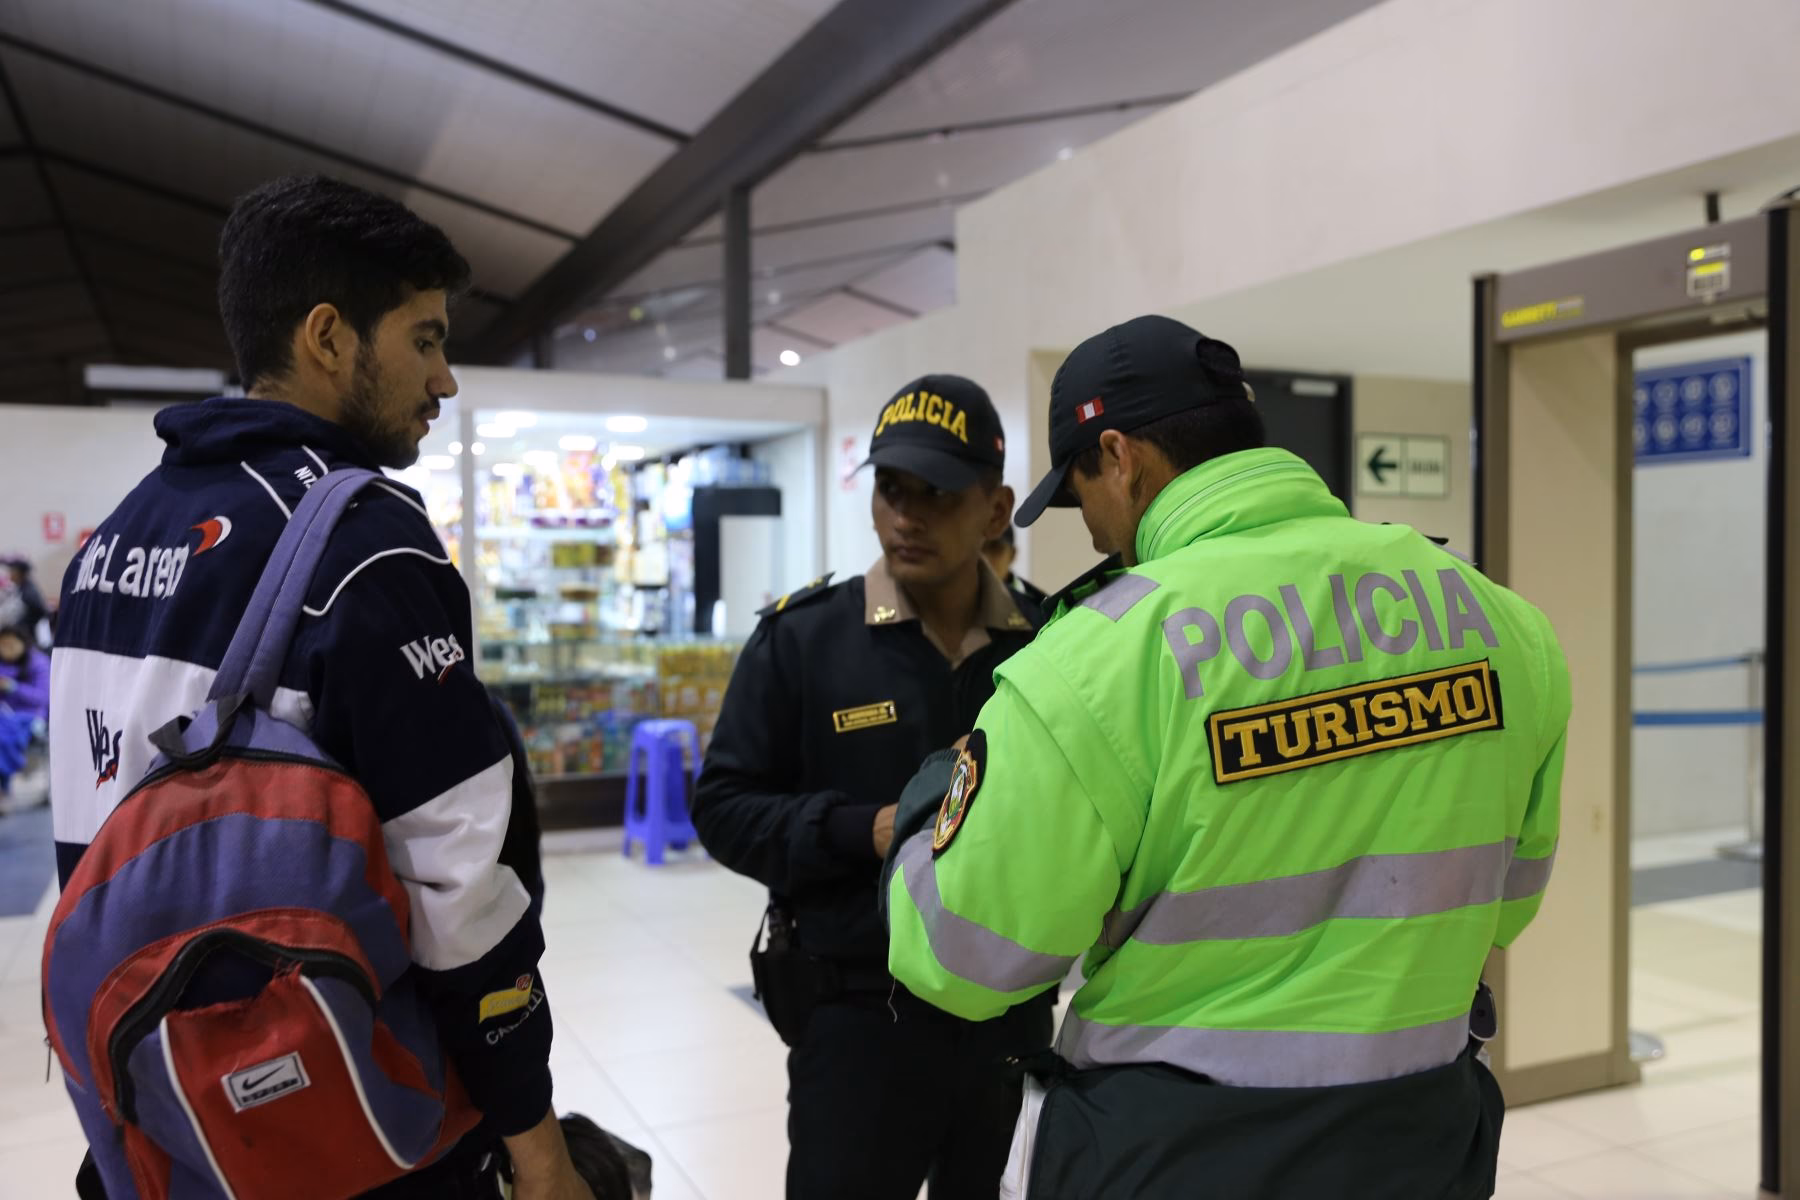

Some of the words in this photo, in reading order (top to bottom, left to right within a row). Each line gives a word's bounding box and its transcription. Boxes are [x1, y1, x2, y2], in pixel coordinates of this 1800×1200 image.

[875, 391, 968, 444] POLICIA
[71, 533, 190, 600] McLaren
[1161, 567, 1500, 701] POLICIA
[1223, 674, 1487, 768] TURISMO
